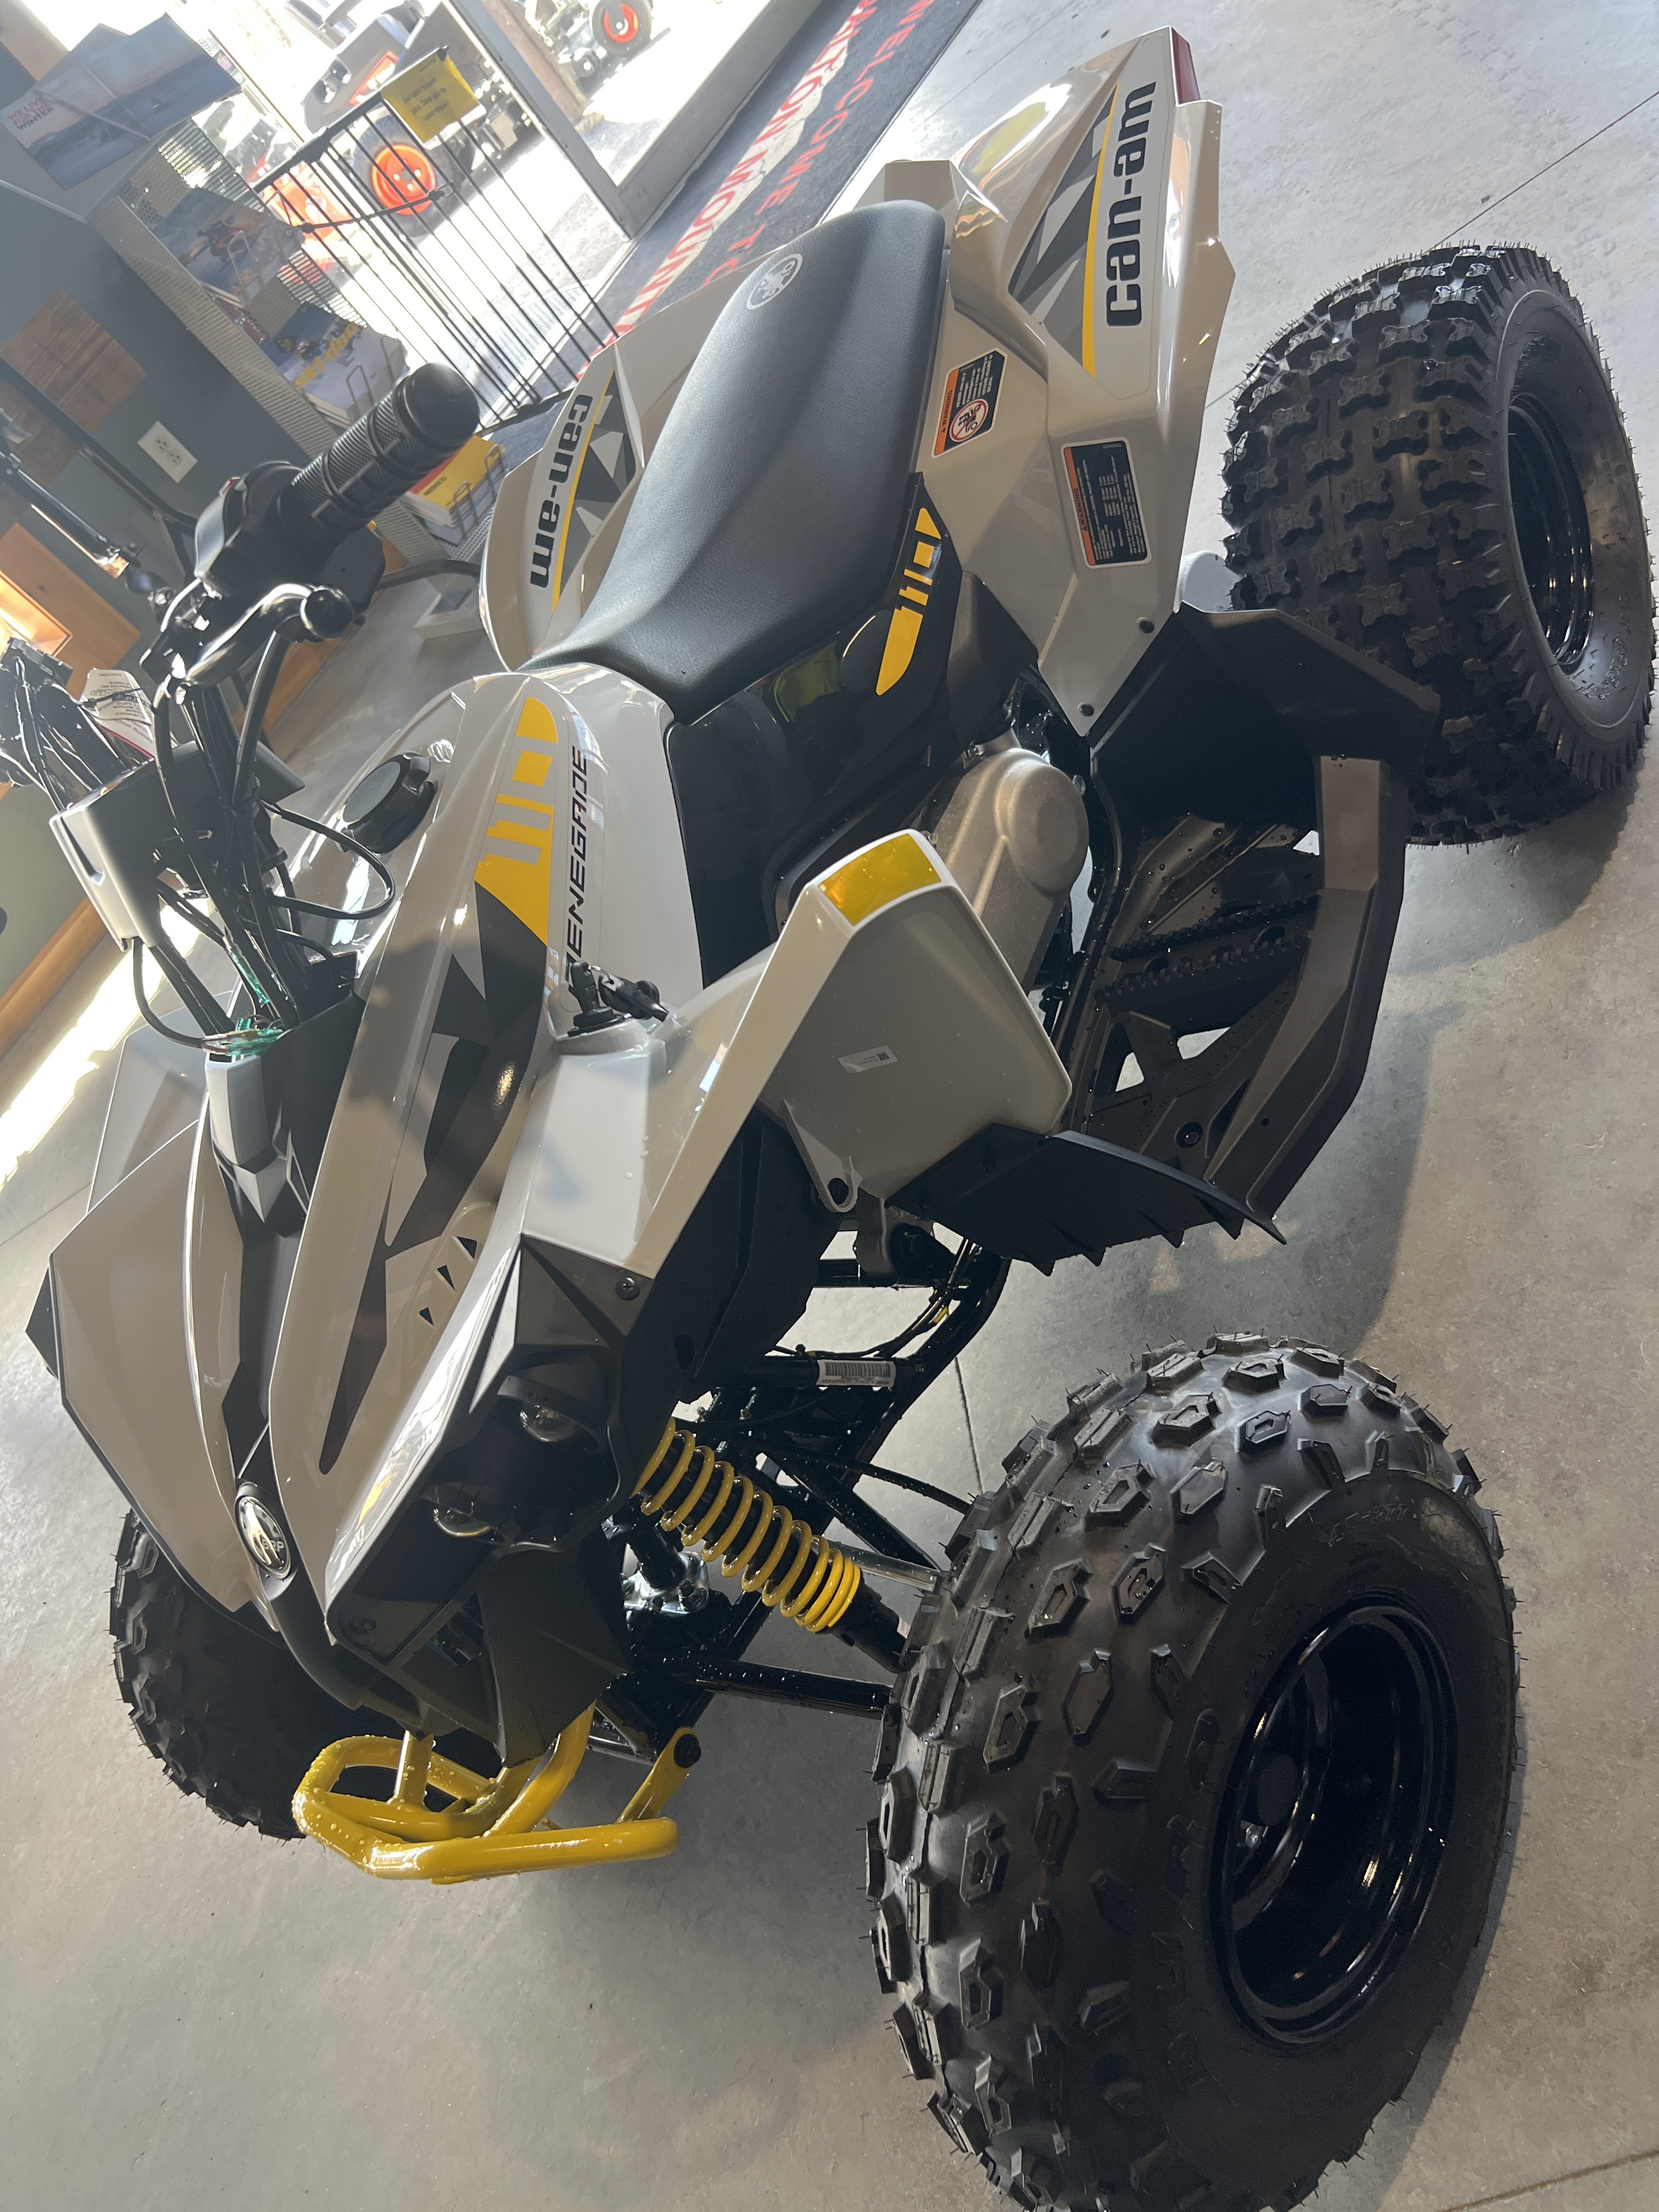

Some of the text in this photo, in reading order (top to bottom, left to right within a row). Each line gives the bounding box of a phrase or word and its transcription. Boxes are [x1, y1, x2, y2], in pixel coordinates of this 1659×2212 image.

[1106, 81, 1156, 327] can-am
[942, 390, 953, 427] WARNING
[530, 394, 592, 588] can-am
[1073, 488, 1087, 526] WARNING
[261, 1539, 285, 1553] BRP
